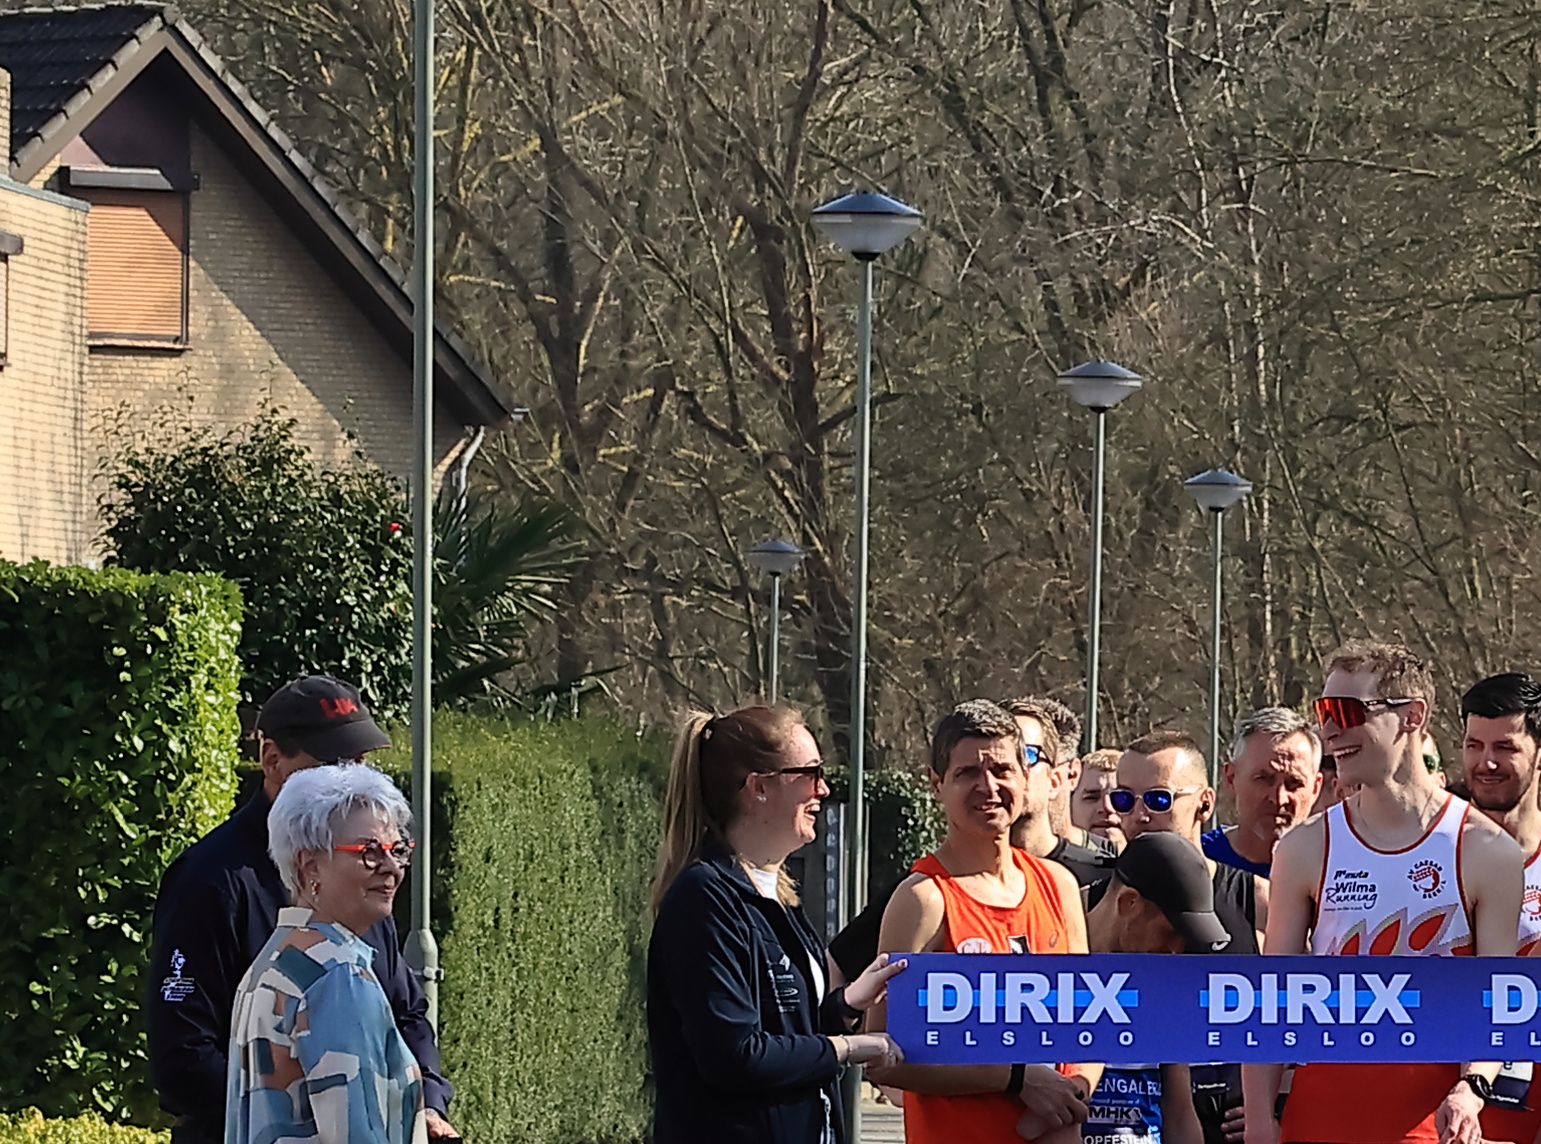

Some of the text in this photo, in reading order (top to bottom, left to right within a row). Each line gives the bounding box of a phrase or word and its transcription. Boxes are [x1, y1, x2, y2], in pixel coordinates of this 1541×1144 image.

[1335, 881, 1377, 893] Wilma
[1325, 887, 1378, 910] Running
[926, 973, 1131, 1023] DIRIX
[1209, 973, 1413, 1024] DIRIX
[926, 1031, 1134, 1046] ELSLOO
[1209, 1031, 1415, 1046] ELSLOO
